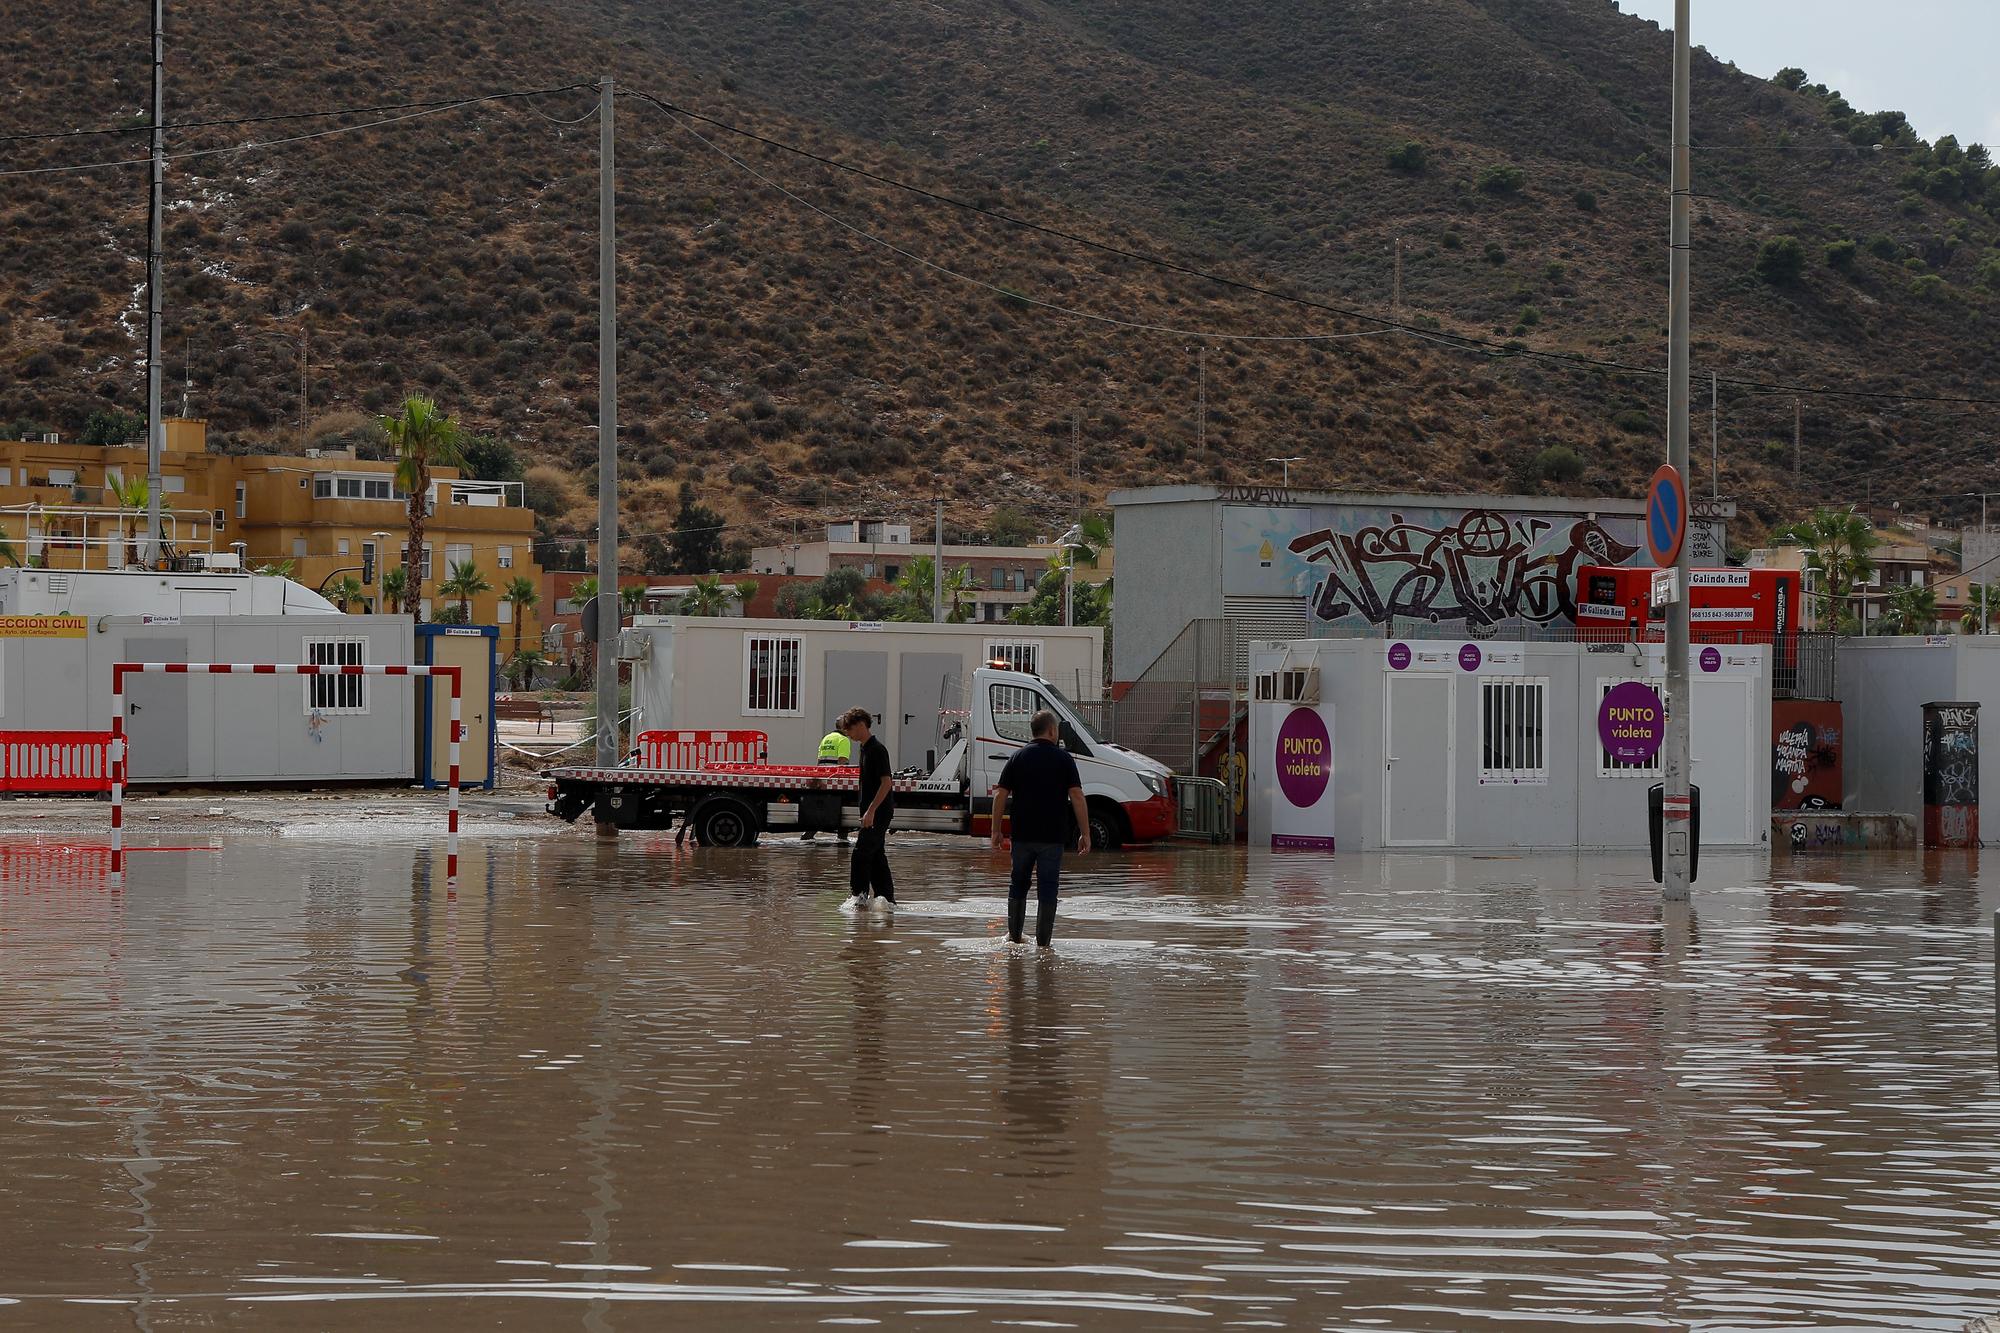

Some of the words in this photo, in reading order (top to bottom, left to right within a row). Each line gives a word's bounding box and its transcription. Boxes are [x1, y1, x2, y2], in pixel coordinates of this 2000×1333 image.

[1693, 574, 1726, 584] Galindo
[1728, 574, 1748, 584] Rent
[1587, 606, 1610, 616] Galindo
[1611, 607, 1625, 617] Rent
[52, 619, 86, 629] CIVIL
[1609, 707, 1655, 721] PUNTO
[1611, 724, 1652, 738] violeta
[1284, 738, 1323, 755] PUNTO
[1286, 759, 1321, 776] violeta
[919, 783, 951, 791] MONZA
